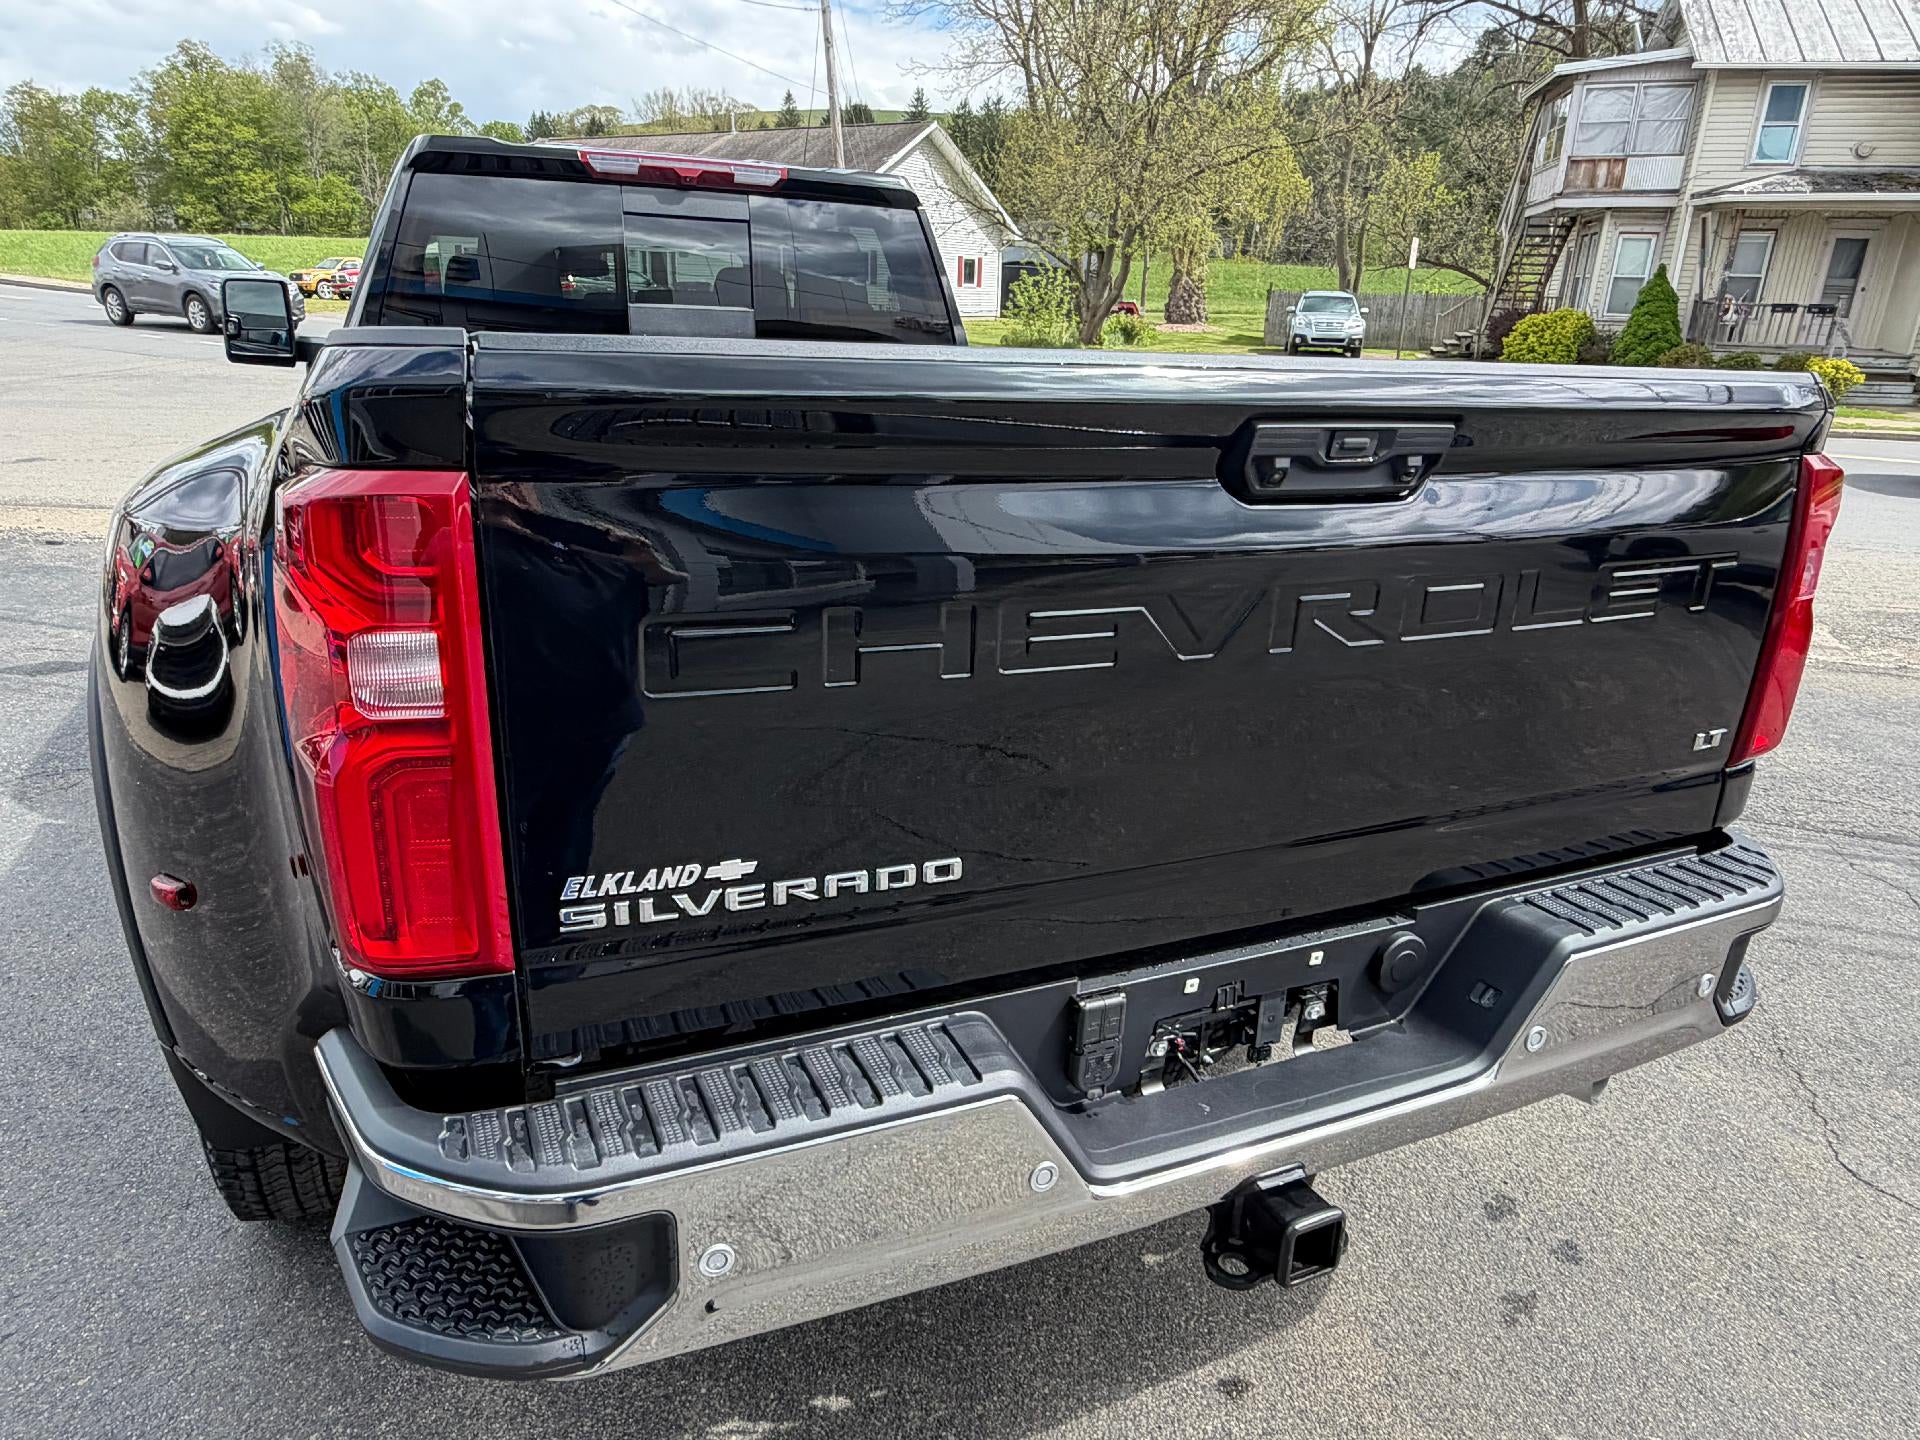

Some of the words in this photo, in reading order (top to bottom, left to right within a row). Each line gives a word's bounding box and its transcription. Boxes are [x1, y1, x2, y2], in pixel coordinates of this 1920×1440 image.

[638, 551, 1739, 699] CHEVROLET
[1693, 728, 1728, 751] LT
[559, 857, 963, 933] SILVERADO
[560, 864, 701, 900] ELKLAND
